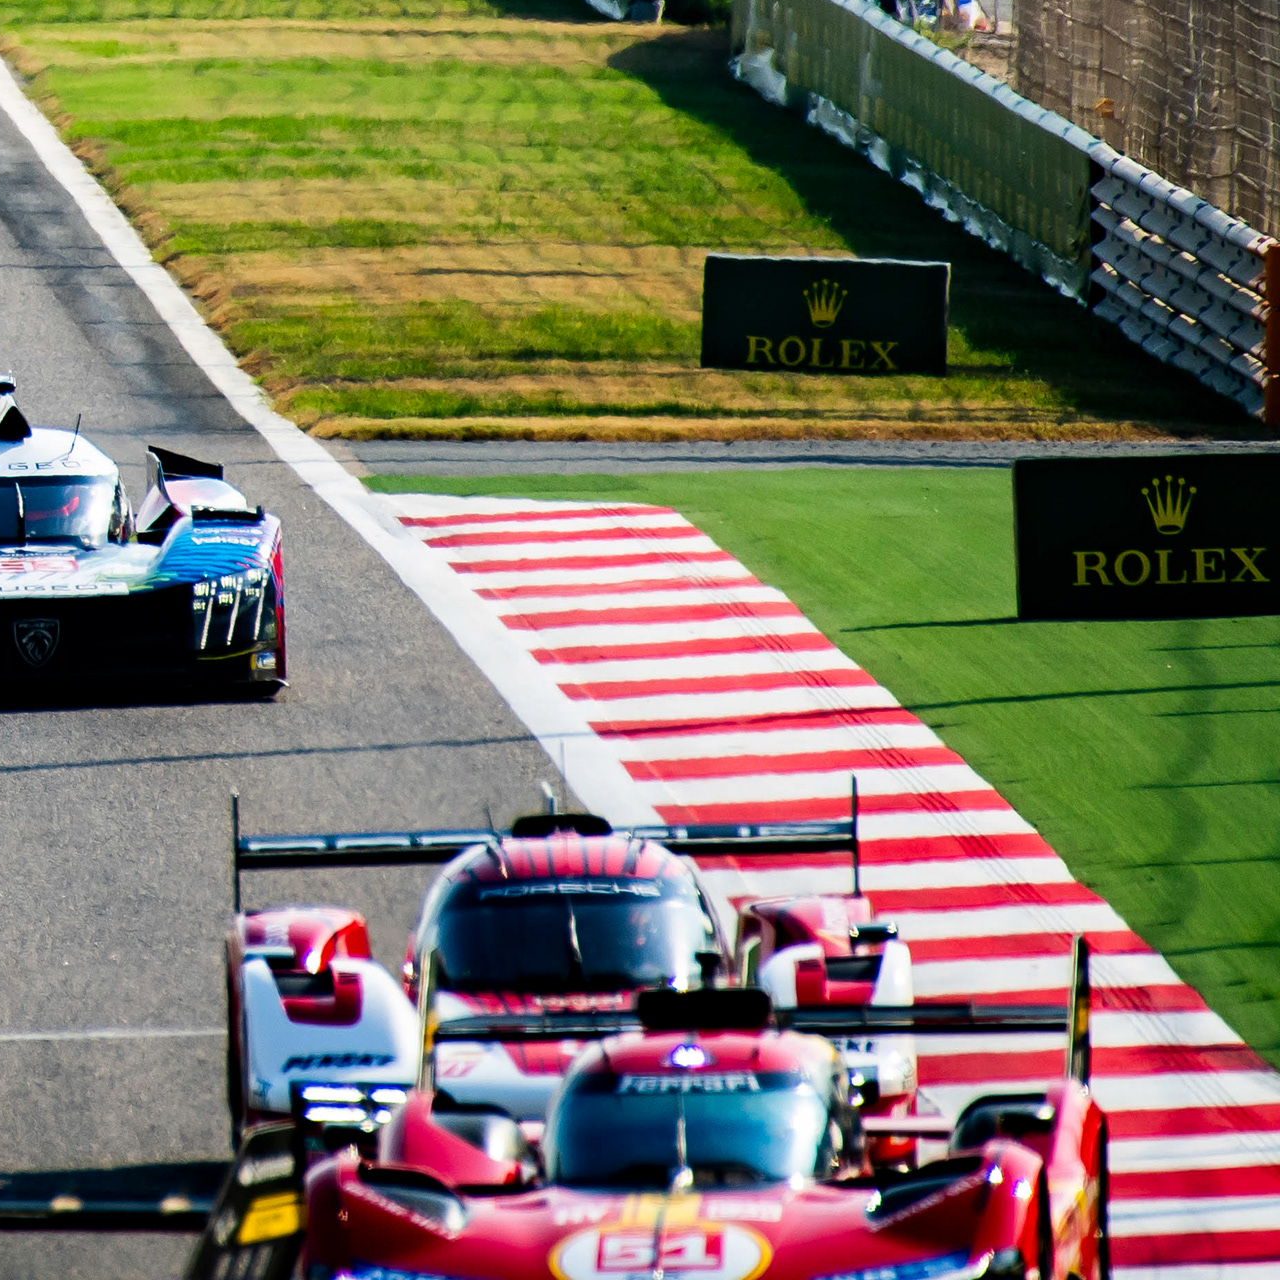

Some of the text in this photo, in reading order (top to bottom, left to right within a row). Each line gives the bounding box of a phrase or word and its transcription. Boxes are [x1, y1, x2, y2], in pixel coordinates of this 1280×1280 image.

[746, 335, 899, 370] ROLEX
[1072, 548, 1270, 587] ROLEX
[602, 1234, 721, 1266] 51
